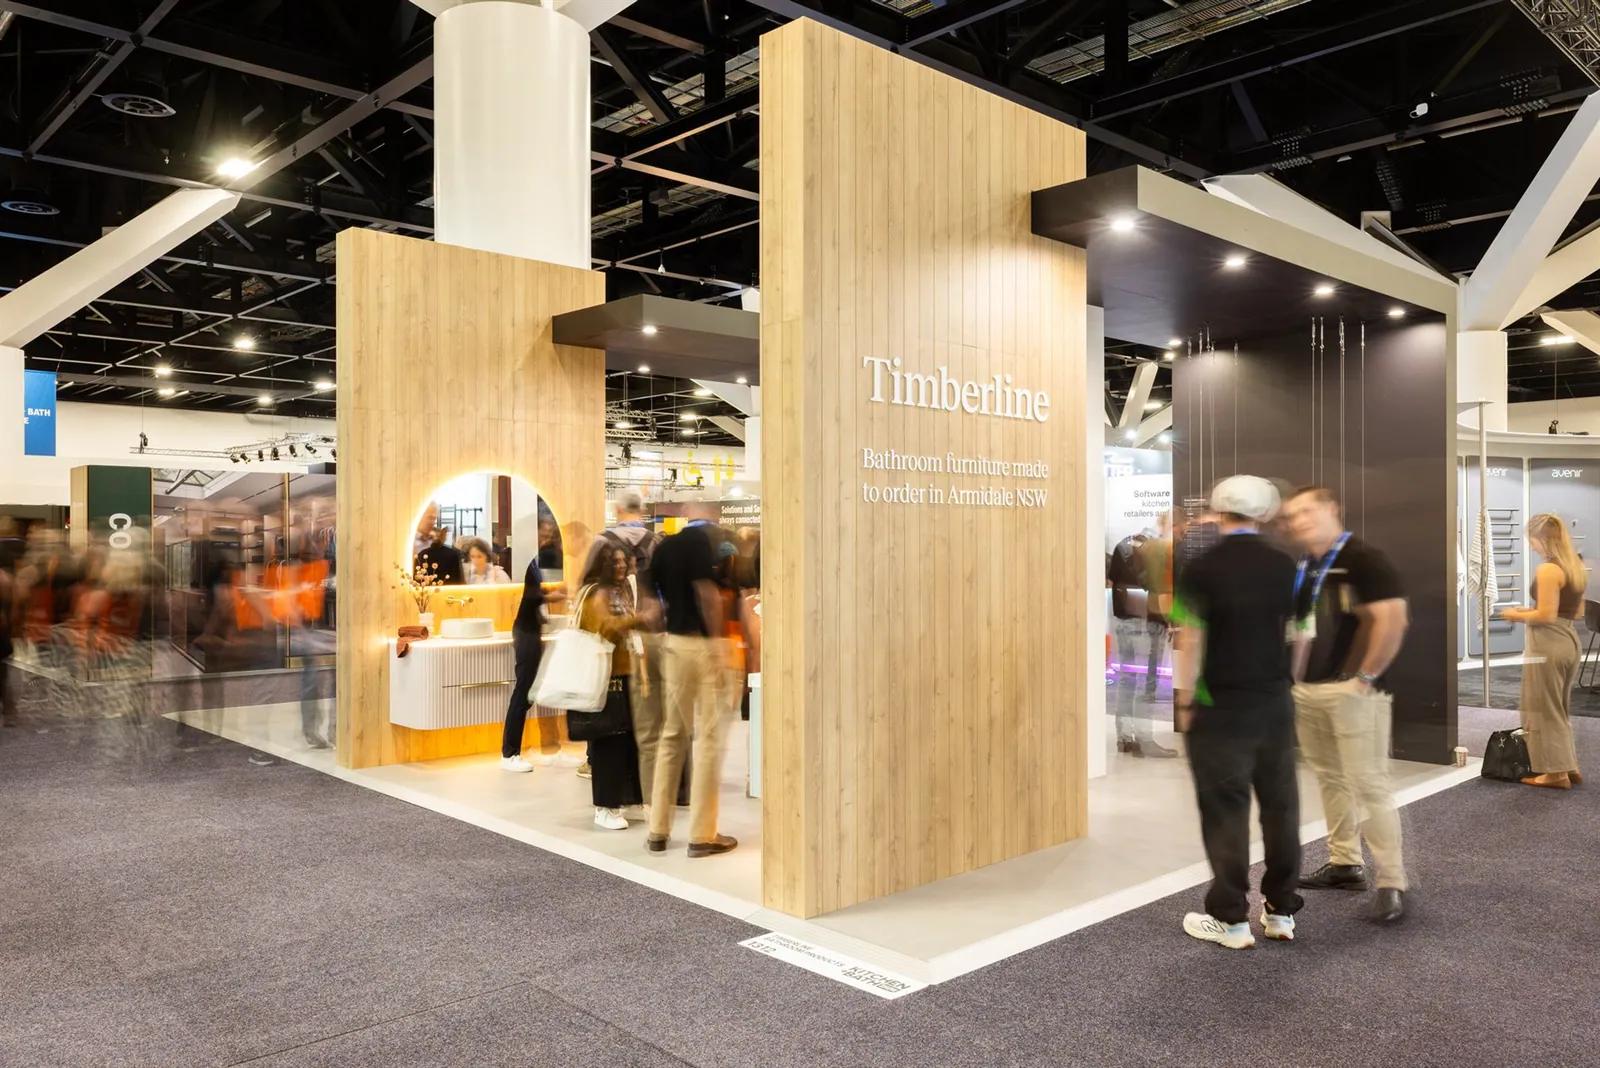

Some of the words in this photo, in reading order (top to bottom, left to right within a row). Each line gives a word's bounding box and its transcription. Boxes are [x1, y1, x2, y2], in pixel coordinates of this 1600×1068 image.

[862, 355, 1050, 422] Timberline
[27, 407, 51, 417] BATH
[862, 447, 943, 472] Bathroom
[946, 452, 1010, 477] furniture
[1012, 460, 1050, 479] made
[1551, 468, 1583, 478] avenir
[862, 483, 880, 504] to
[882, 483, 927, 505] order
[928, 483, 944, 505] in
[947, 484, 1014, 507] Armidale
[1015, 487, 1049, 508] NSW
[1133, 490, 1171, 498] Software
[721, 505, 743, 514] Solutions
[744, 505, 753, 514] and
[1124, 510, 1154, 518] retailers
[719, 516, 735, 525] always
[735, 515, 760, 524] connected
[848, 966, 911, 990] KITCHEN
